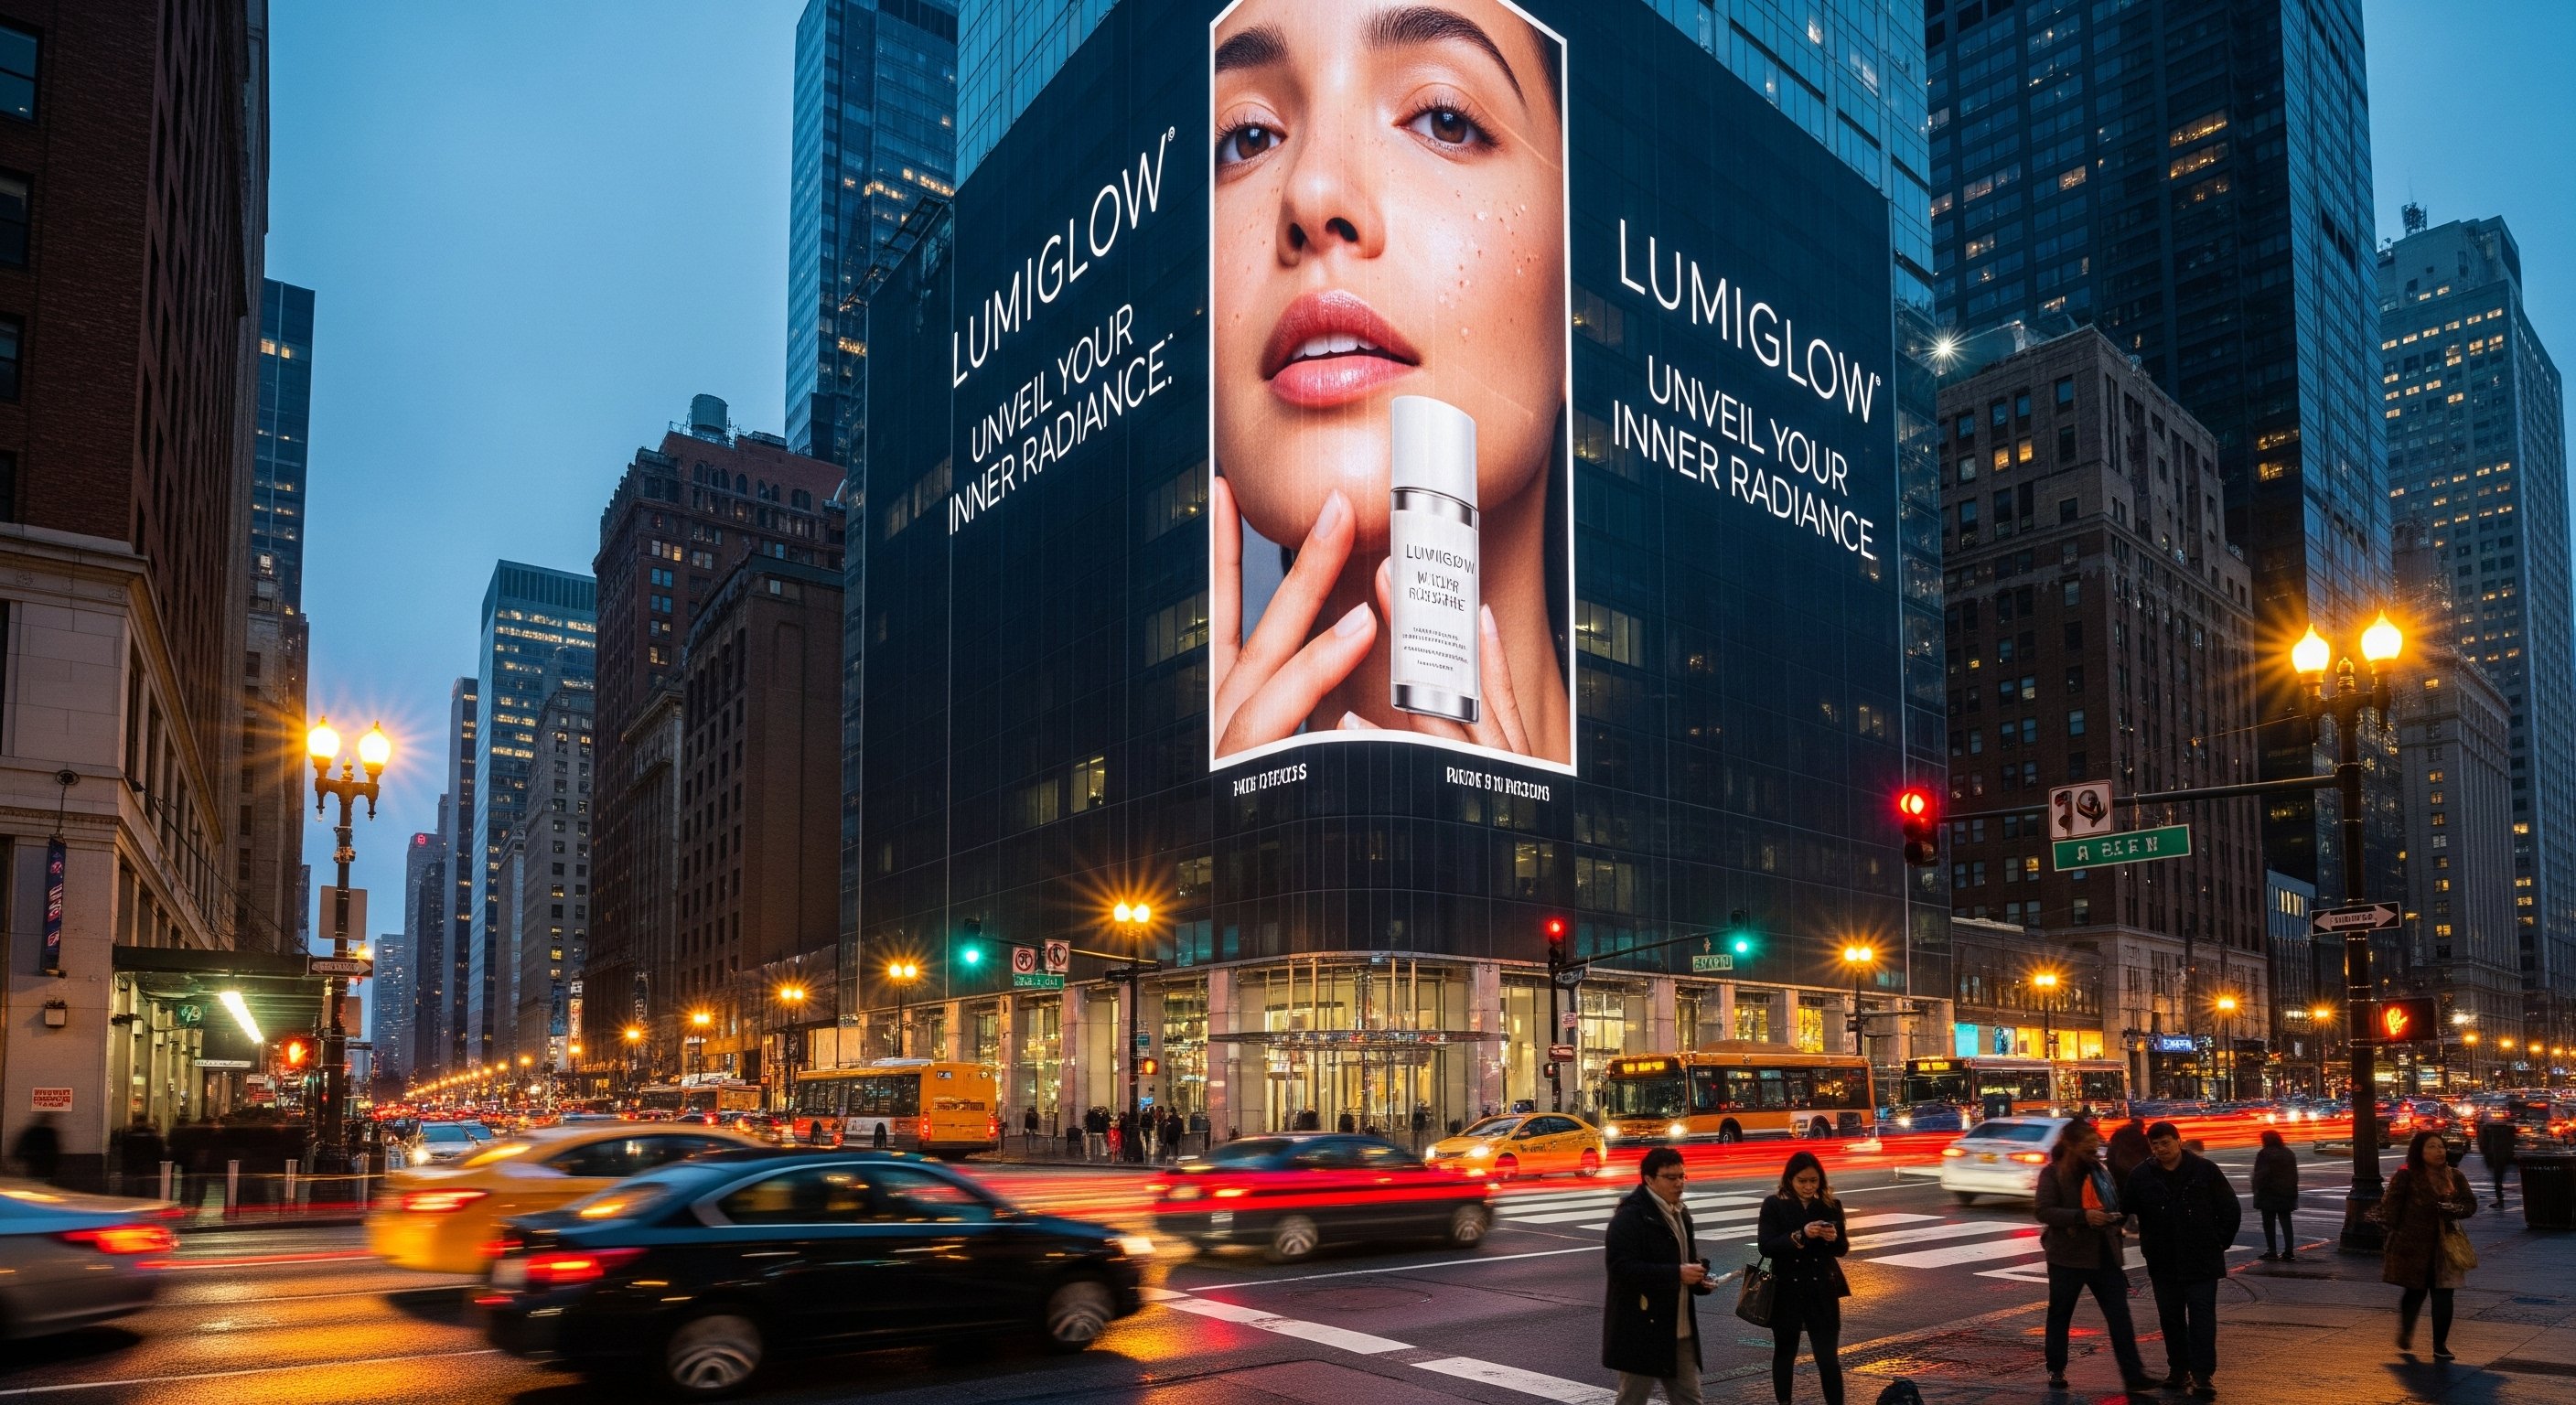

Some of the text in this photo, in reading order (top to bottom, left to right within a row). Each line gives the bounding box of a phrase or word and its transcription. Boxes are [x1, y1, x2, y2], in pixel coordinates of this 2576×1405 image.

[971, 304, 1133, 463] UNVEIL YOUR
[1648, 354, 1849, 497] UNVEIL YOUR
[950, 454, 1015, 536] INNER
[1614, 400, 1720, 490] INNER
